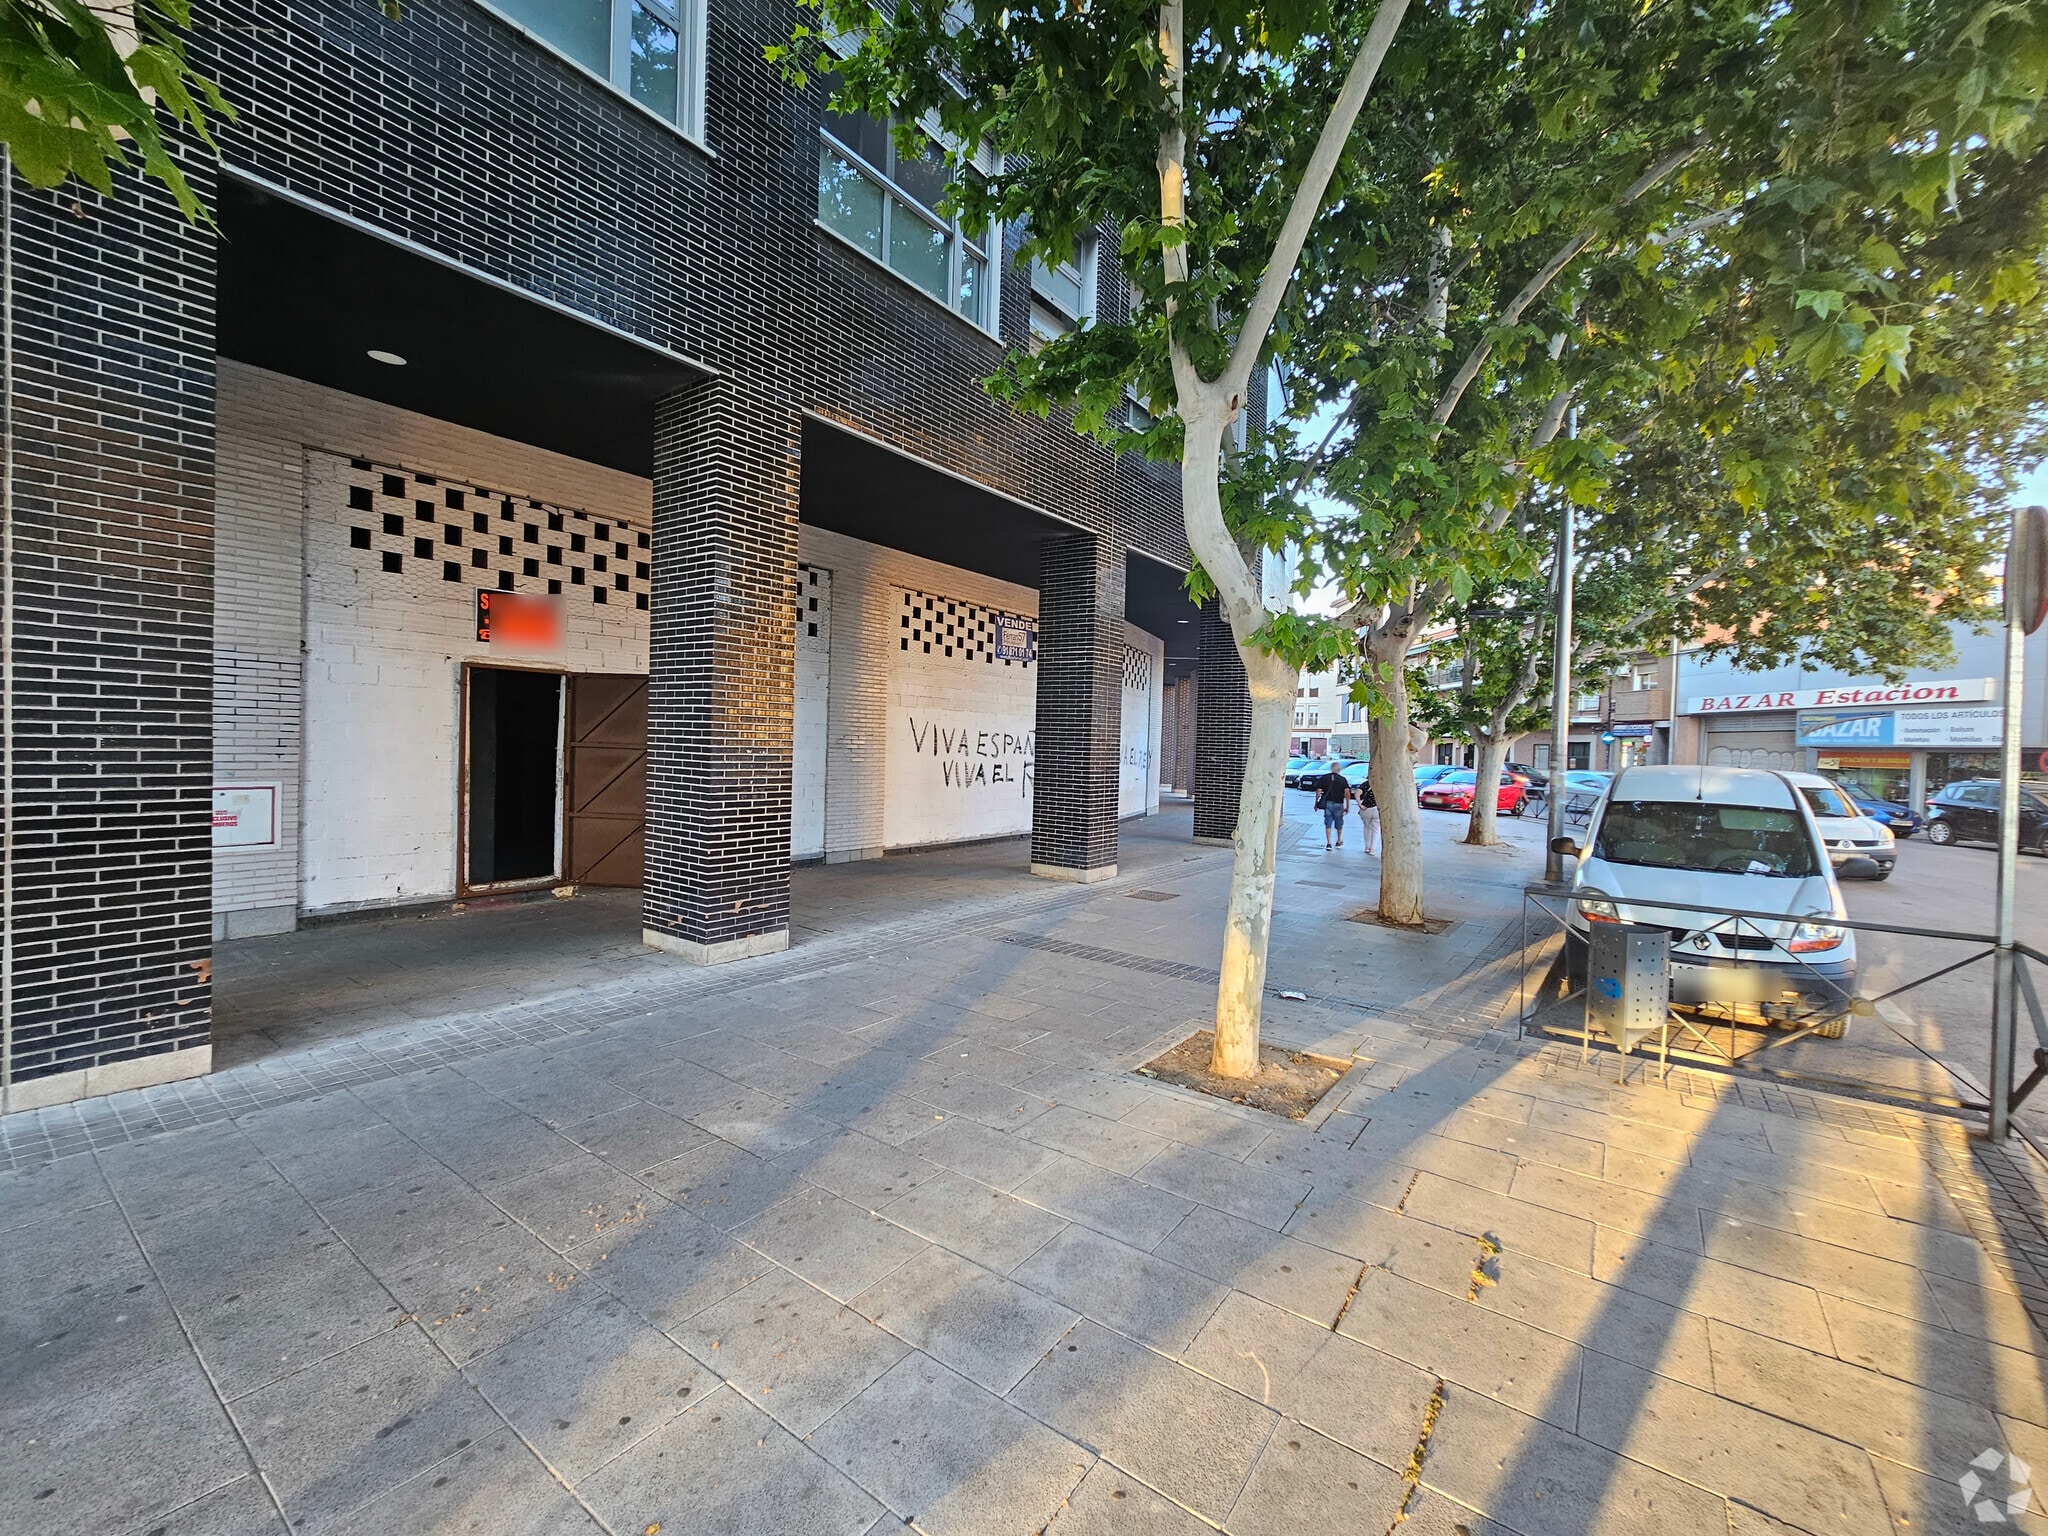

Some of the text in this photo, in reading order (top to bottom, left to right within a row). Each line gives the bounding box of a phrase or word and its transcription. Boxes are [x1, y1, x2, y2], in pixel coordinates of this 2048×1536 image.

[996, 616, 1033, 631] VENDE
[1700, 684, 1960, 711] BAZAR Estacion
[1901, 712, 1929, 720] TODOS
[1931, 711, 1949, 720] LOS
[909, 716, 1036, 759] VIVA ESPAÑ
[942, 759, 987, 789] VIVA
[992, 763, 1014, 784] EL
